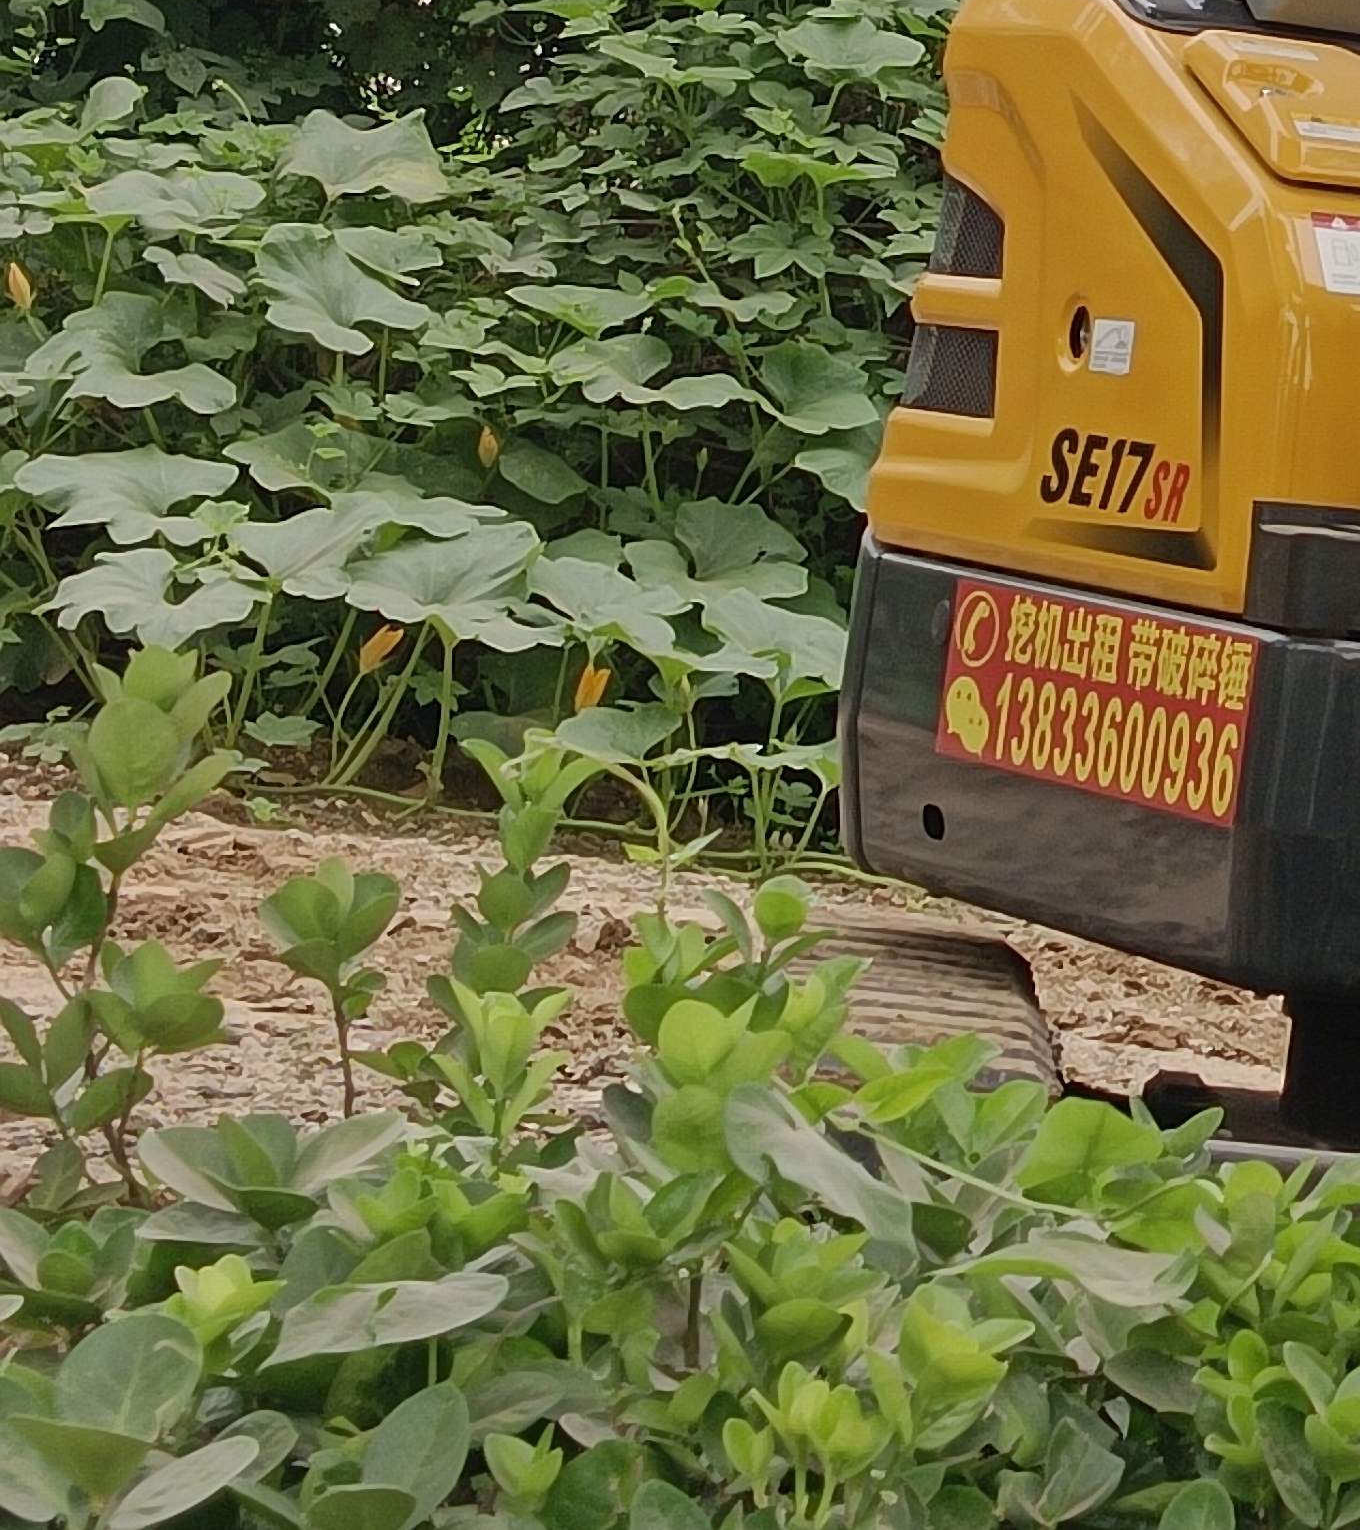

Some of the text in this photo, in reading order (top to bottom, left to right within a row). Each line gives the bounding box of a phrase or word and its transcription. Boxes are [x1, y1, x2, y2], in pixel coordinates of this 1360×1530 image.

[1004, 593, 1253, 711] 挖机出租 带破碎锤
[995, 672, 1239, 818] 13833600936
